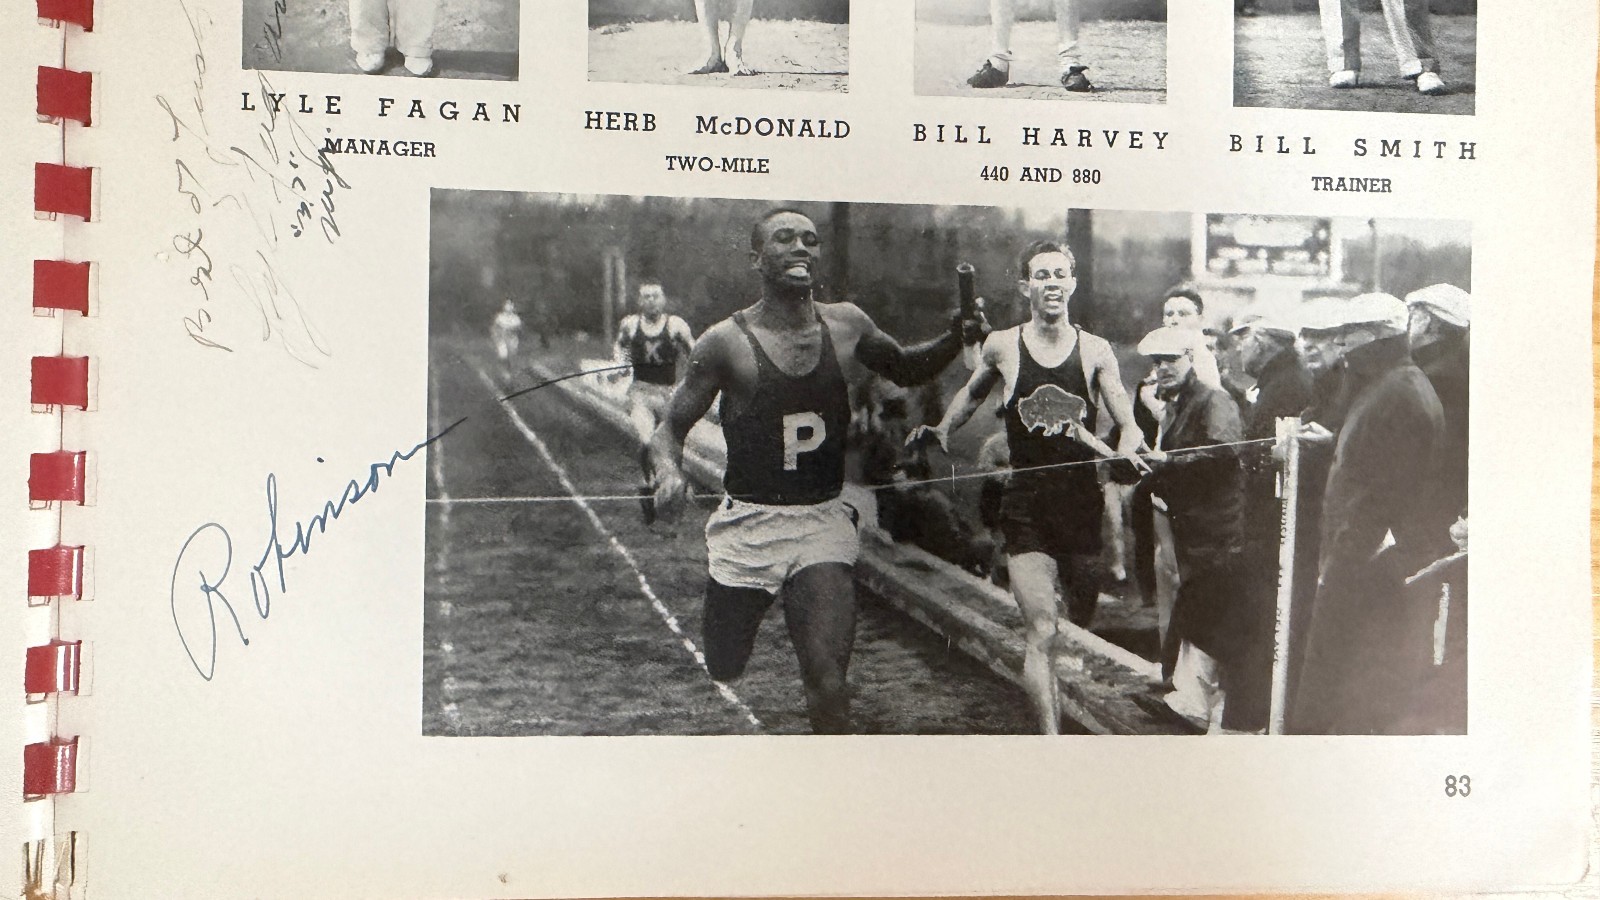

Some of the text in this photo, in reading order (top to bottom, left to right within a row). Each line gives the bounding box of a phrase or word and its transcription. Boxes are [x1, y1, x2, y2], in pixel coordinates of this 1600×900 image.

[241, 92, 522, 123] LYLE FAGAN
[584, 110, 851, 139] HERB McDONALD
[913, 123, 1169, 150] BILL HARVEY
[324, 137, 437, 158] MANAGER
[1229, 134, 1477, 161] BILL SMITH
[665, 155, 770, 175] TWO-MILE
[980, 166, 1101, 185] 440 AND 880
[1311, 176, 1393, 194] TRAINER
[782, 412, 827, 471] P
[172, 416, 468, 681] Robinson
[1444, 774, 1472, 798] 83
